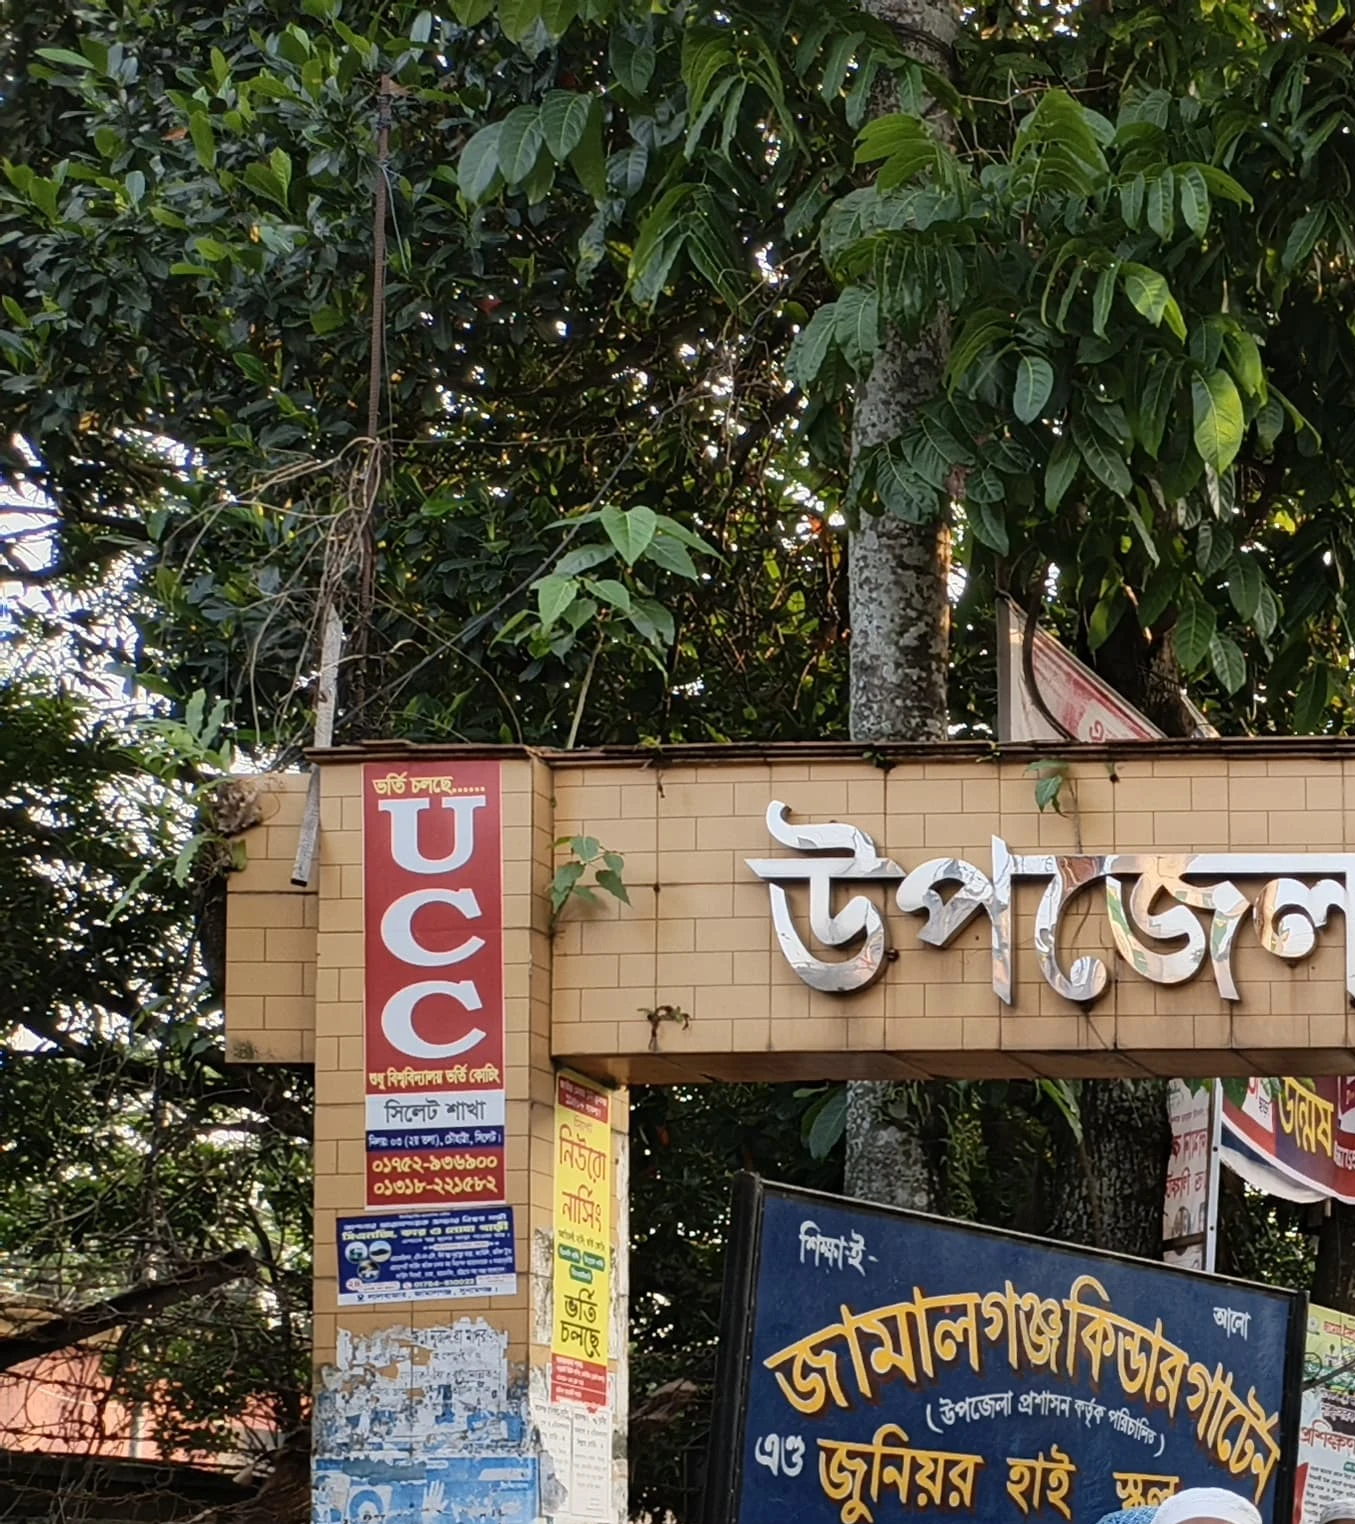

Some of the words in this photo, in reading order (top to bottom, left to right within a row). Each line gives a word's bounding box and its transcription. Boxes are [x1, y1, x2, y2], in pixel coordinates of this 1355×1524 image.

[372, 772, 408, 796] ভর্তি
[445, 1064, 468, 1085] ভর্তি
[469, 1063, 500, 1084] কোচিং
[384, 1097, 440, 1124] সিলেট
[446, 1099, 487, 1122] শাখা
[560, 1124, 606, 1183] নিউরো
[562, 1184, 602, 1232] নার্সিং
[564, 1288, 598, 1323] ভর্তি
[560, 1320, 601, 1358] চলছে
[1017, 1392, 1070, 1420] প্রশাসন
[1074, 1396, 1106, 1427] কর্তৃক
[1006, 1445, 1078, 1520] হাই
